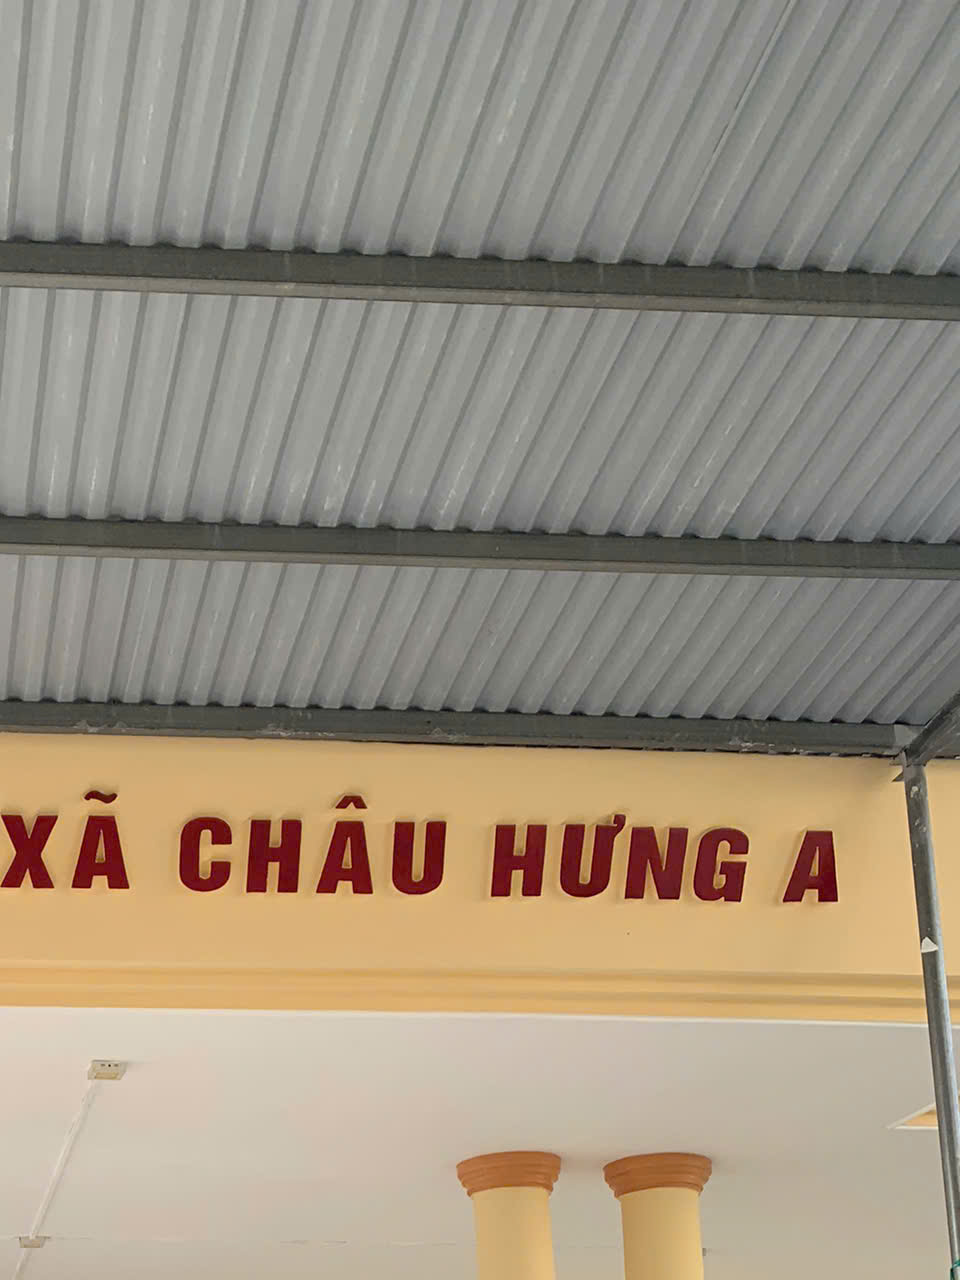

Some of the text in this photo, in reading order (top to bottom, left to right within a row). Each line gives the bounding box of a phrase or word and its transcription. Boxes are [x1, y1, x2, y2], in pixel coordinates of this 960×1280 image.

[0, 790, 130, 890] XÃ
[178, 795, 447, 895] CHÂU
[490, 814, 750, 902] HƯNG
[782, 830, 839, 903] A
